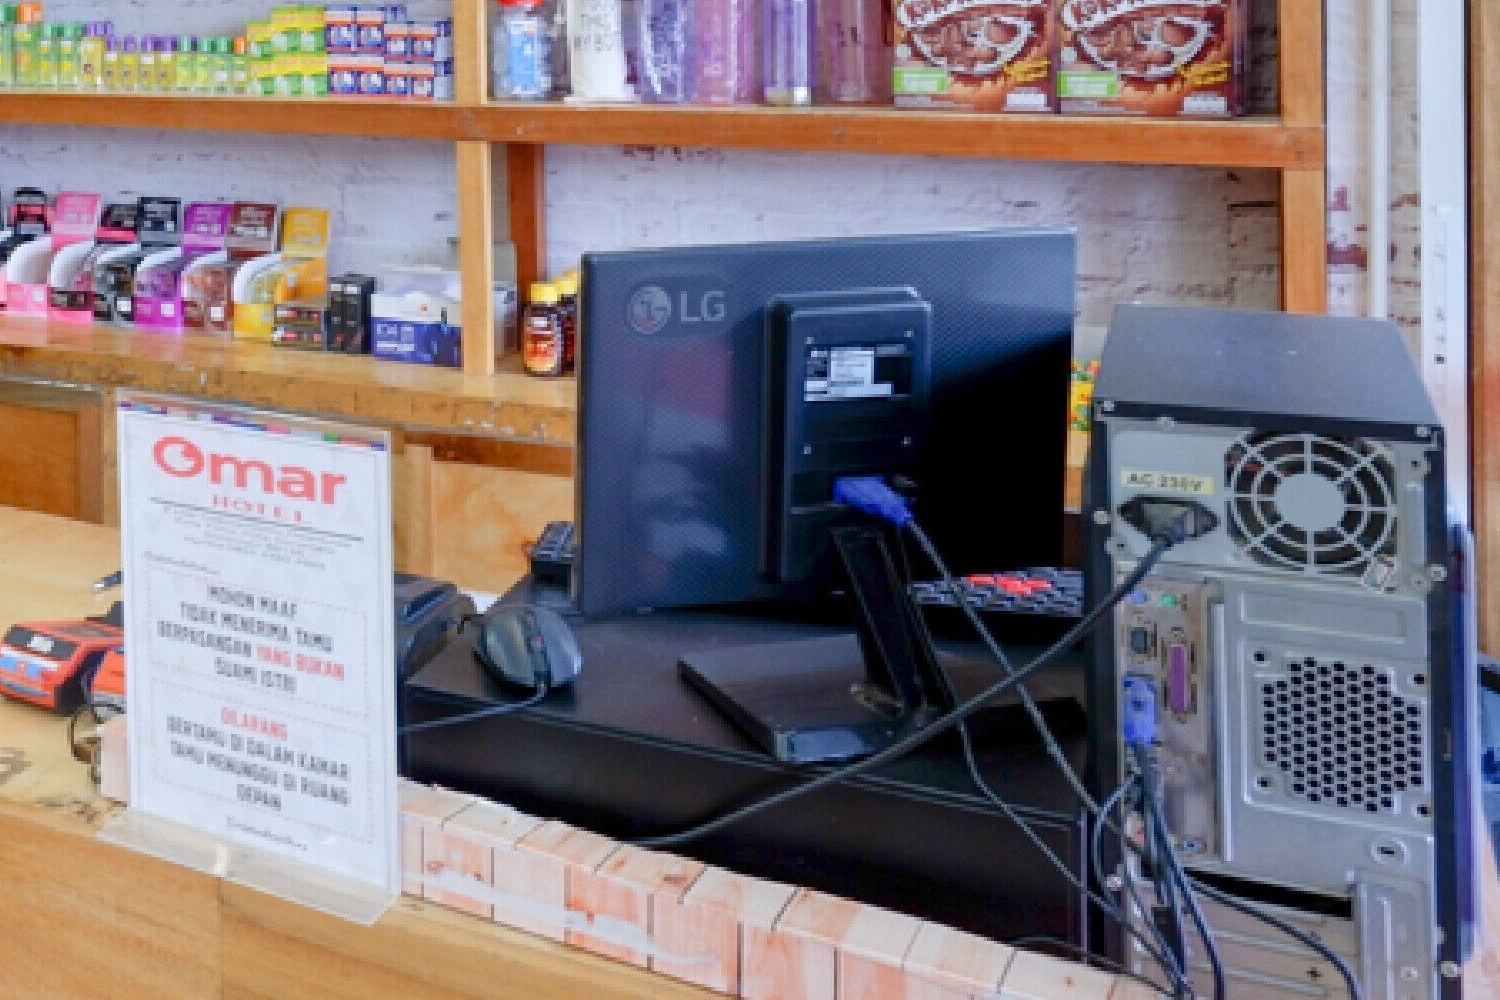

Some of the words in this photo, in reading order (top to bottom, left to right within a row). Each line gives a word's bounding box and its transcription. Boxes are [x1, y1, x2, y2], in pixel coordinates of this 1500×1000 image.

[679, 290, 725, 322] LG
[152, 436, 347, 504] Omar
[1127, 473, 1152, 486] AC
[213, 495, 303, 522] HOTEL
[208, 586, 254, 609] MOHON
[260, 597, 298, 619] MAAF
[180, 601, 217, 624] TIDAK
[221, 612, 290, 640] MENERIMA
[296, 629, 333, 653] TAMU
[158, 620, 252, 656] BERPASANGAN
[256, 645, 292, 668] YANG
[296, 653, 344, 680] BUKAN
[216, 657, 256, 683] SUAMI
[261, 670, 296, 693] ISTRI
[221, 707, 287, 741] DILARANG
[167, 715, 227, 748] BERTAMU
[230, 733, 244, 751] DI
[247, 739, 295, 765] DALAM
[299, 753, 349, 781] KAMAR
[170, 741, 205, 765] TAMU
[207, 753, 278, 787] MENUNGGU
[283, 772, 297, 791] DI
[300, 780, 350, 806] RUANG
[237, 783, 281, 811] DEPAN
